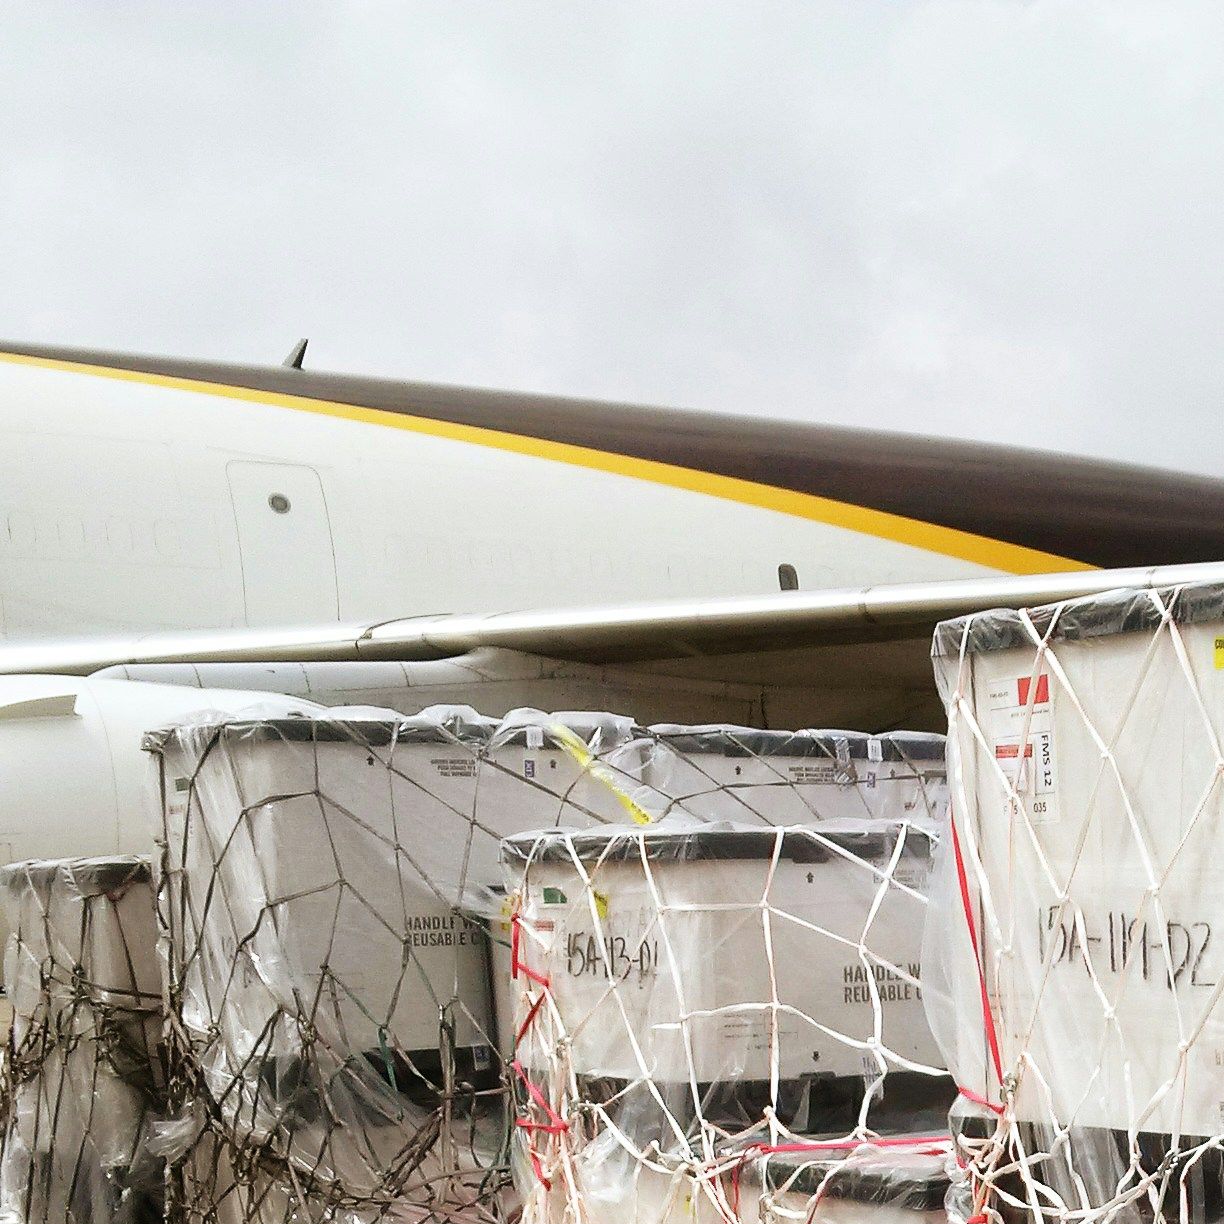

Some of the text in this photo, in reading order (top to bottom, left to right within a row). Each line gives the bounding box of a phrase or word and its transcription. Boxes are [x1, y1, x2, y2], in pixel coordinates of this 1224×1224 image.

[1041, 734, 1052, 787] FMS 12
[1033, 802, 1047, 813] 035
[843, 984, 912, 1004] REUABLE
